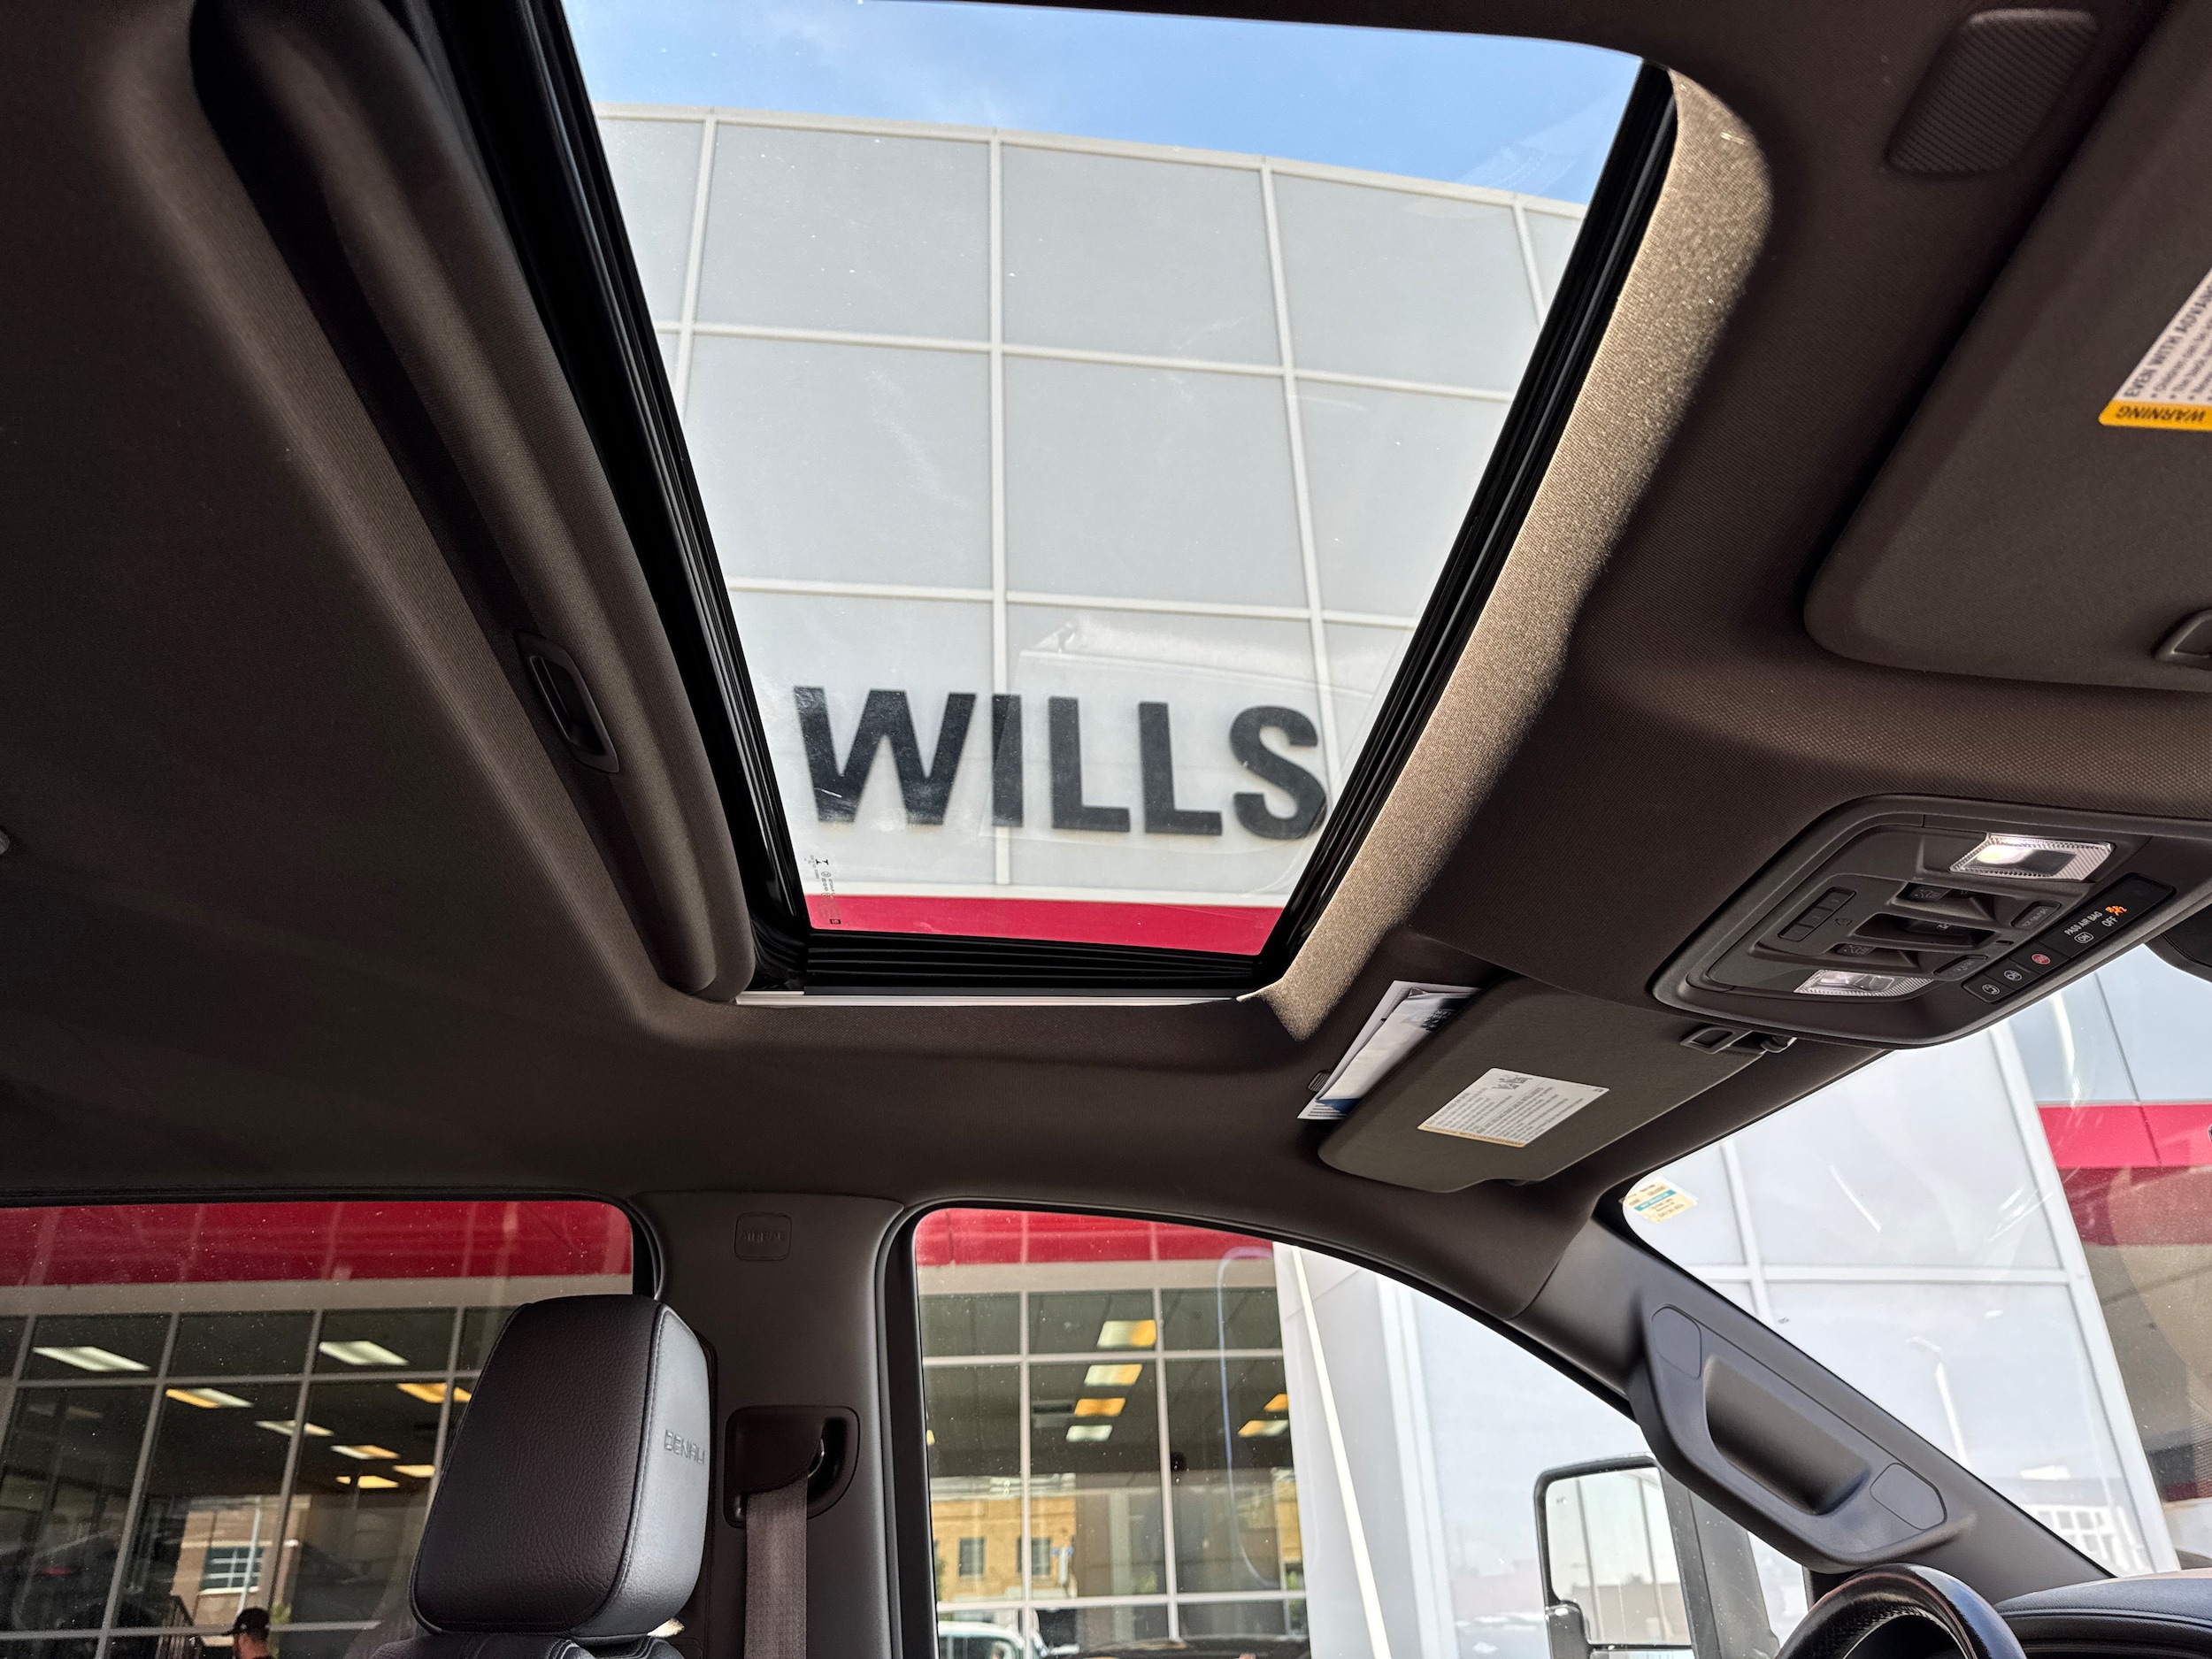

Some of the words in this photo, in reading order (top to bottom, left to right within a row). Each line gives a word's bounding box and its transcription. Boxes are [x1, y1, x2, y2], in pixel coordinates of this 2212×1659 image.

[2124, 369, 2156, 396] EVEN
[2148, 335, 2181, 365] WITH
[2116, 405, 2206, 422] WARNING
[794, 685, 1328, 841] WILLS
[2063, 924, 2082, 936] PASS
[2078, 918, 2092, 928] AIR
[2086, 910, 2103, 922] BAG
[2101, 915, 2118, 927] OFF
